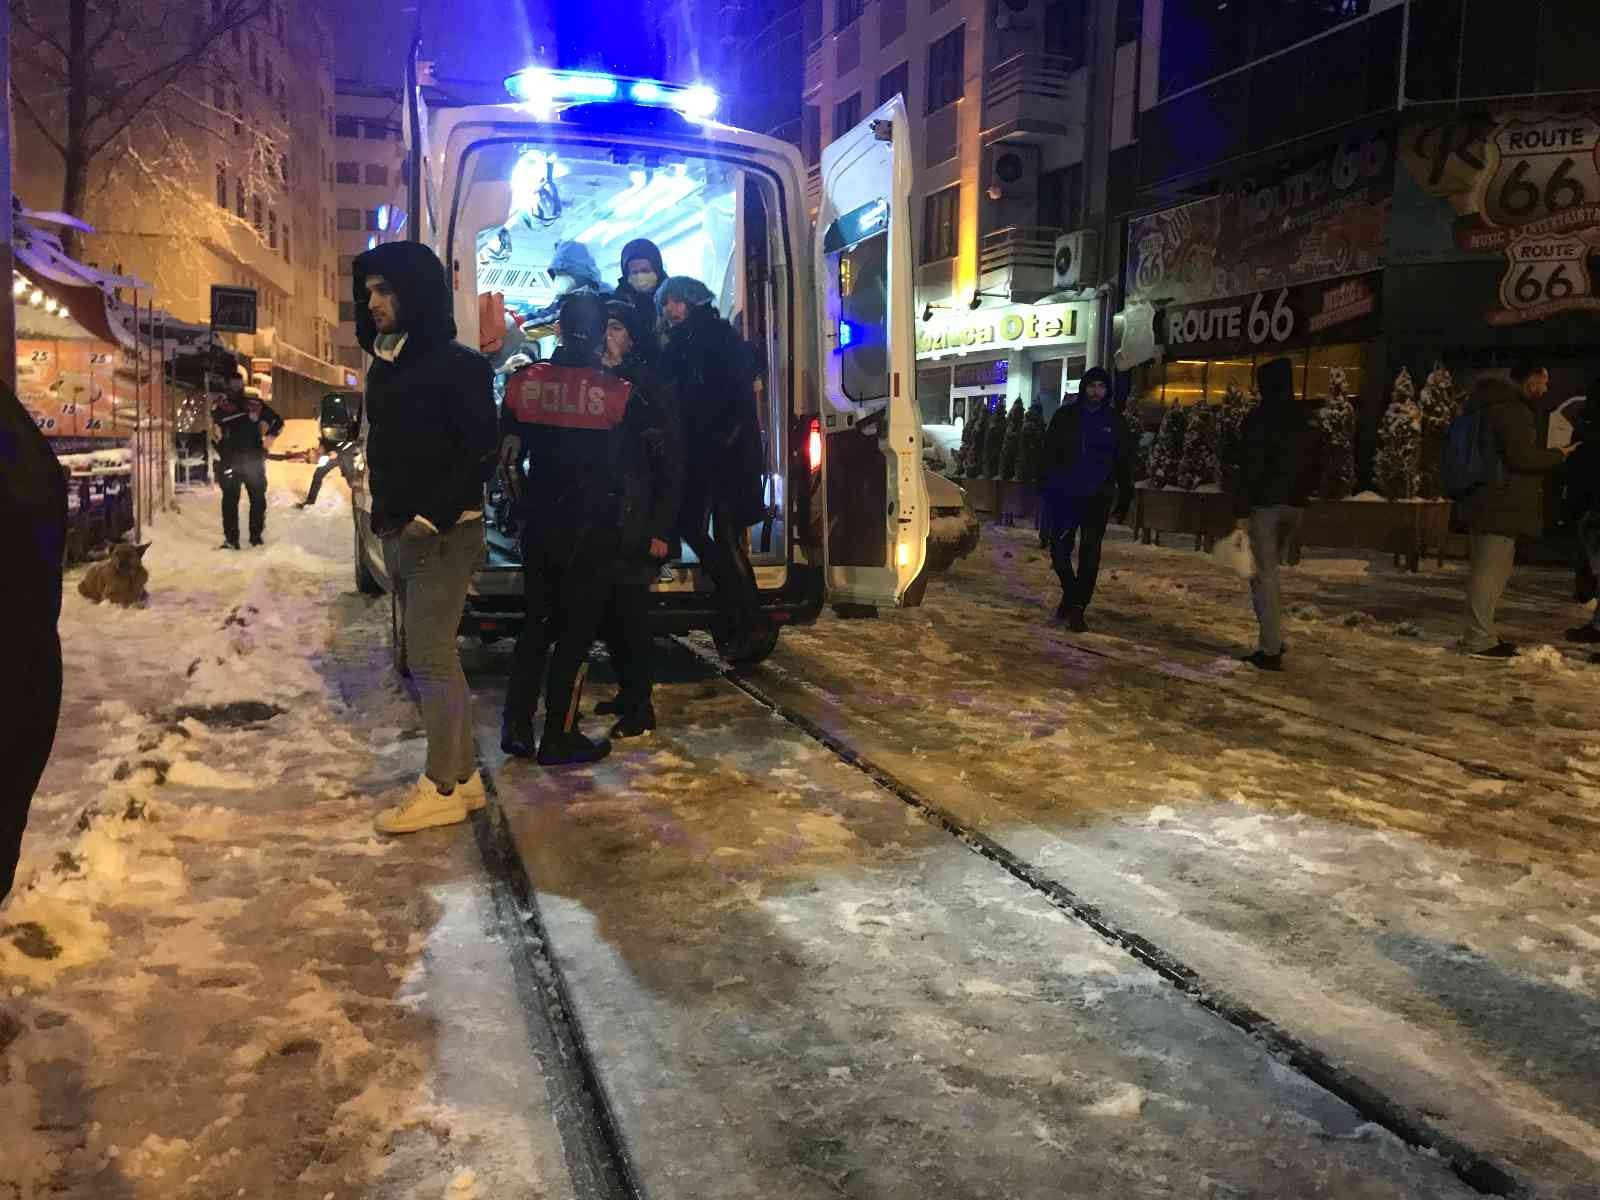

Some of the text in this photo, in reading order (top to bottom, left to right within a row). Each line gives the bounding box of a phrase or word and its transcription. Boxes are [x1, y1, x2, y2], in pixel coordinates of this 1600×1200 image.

[1510, 127, 1584, 149] ROUTE
[1500, 157, 1585, 214] 66
[1521, 245, 1575, 258] ROUTE
[1515, 264, 1572, 303] 66
[1000, 310, 1078, 340] Otel
[1169, 306, 1241, 344] ROUTE
[1248, 288, 1295, 344] 66
[32, 351, 48, 361] 25
[521, 379, 606, 415] POLİS
[38, 419, 54, 428] 20
